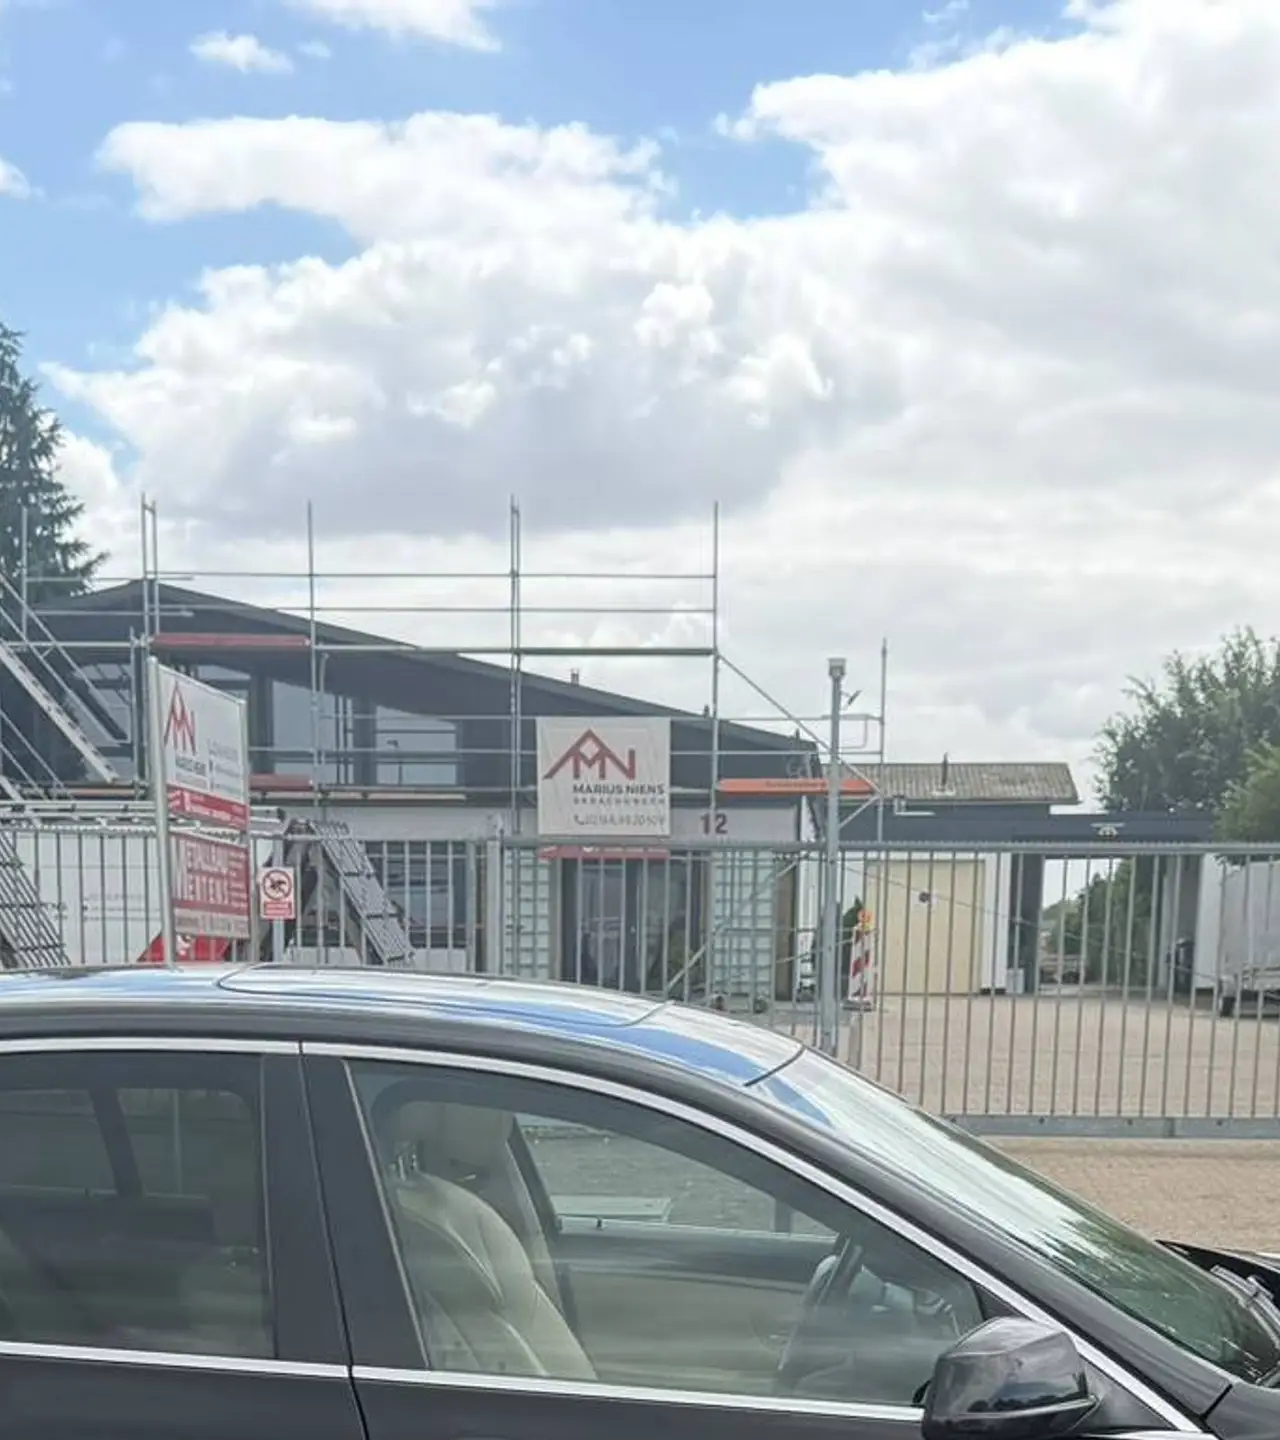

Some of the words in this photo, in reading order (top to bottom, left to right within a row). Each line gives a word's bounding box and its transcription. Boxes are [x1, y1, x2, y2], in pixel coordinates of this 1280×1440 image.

[573, 784, 623, 794] MARIUS
[626, 784, 665, 794] NIENS
[700, 812, 728, 835] 12
